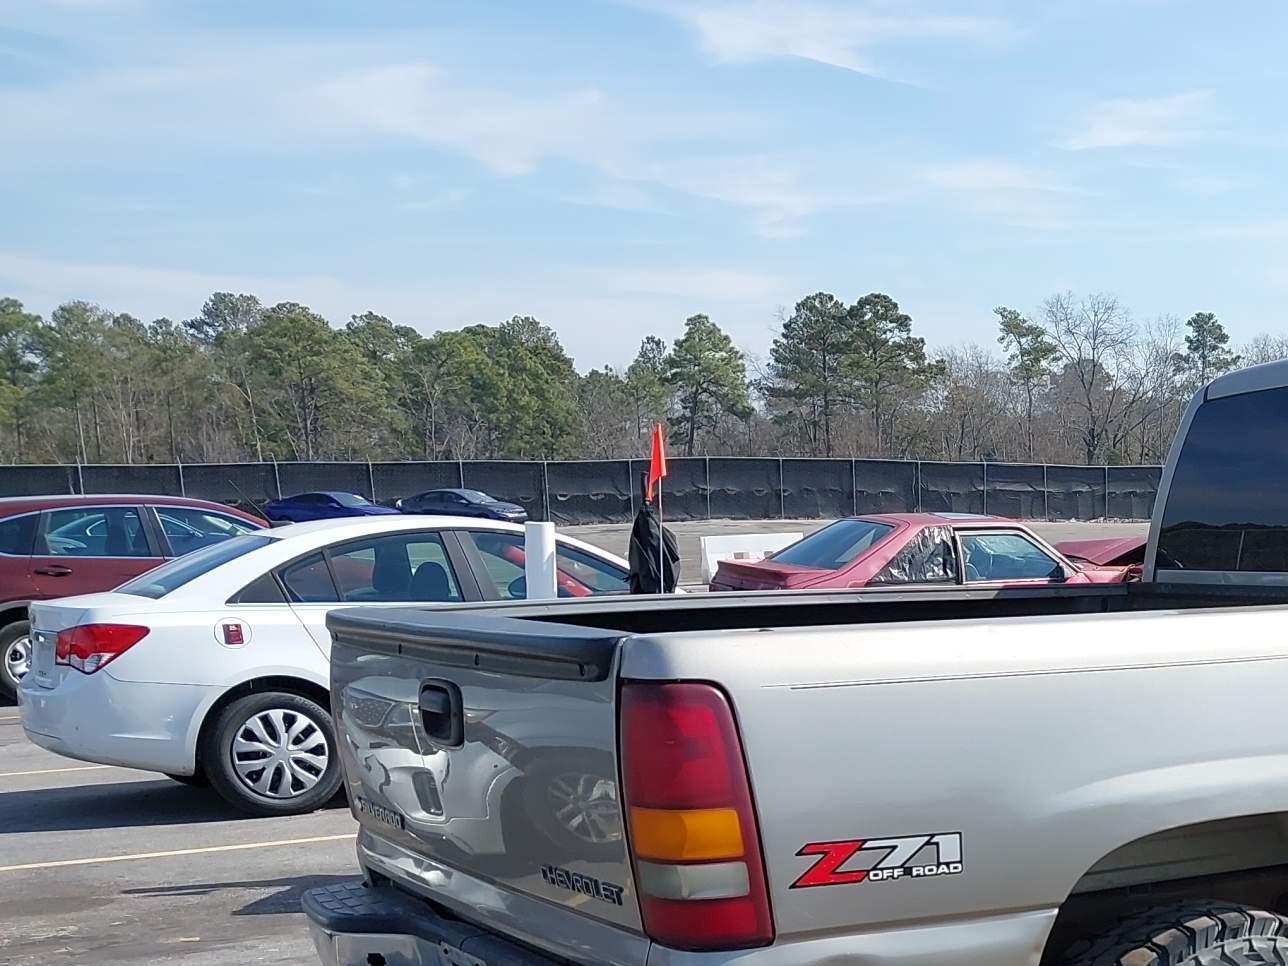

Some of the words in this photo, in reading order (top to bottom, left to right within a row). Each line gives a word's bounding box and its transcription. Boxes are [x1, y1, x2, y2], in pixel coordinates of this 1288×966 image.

[788, 832, 962, 889] Z71
[868, 867, 904, 881] OFF
[911, 862, 963, 877] ROAD
[540, 864, 624, 906] CHEVROLET
